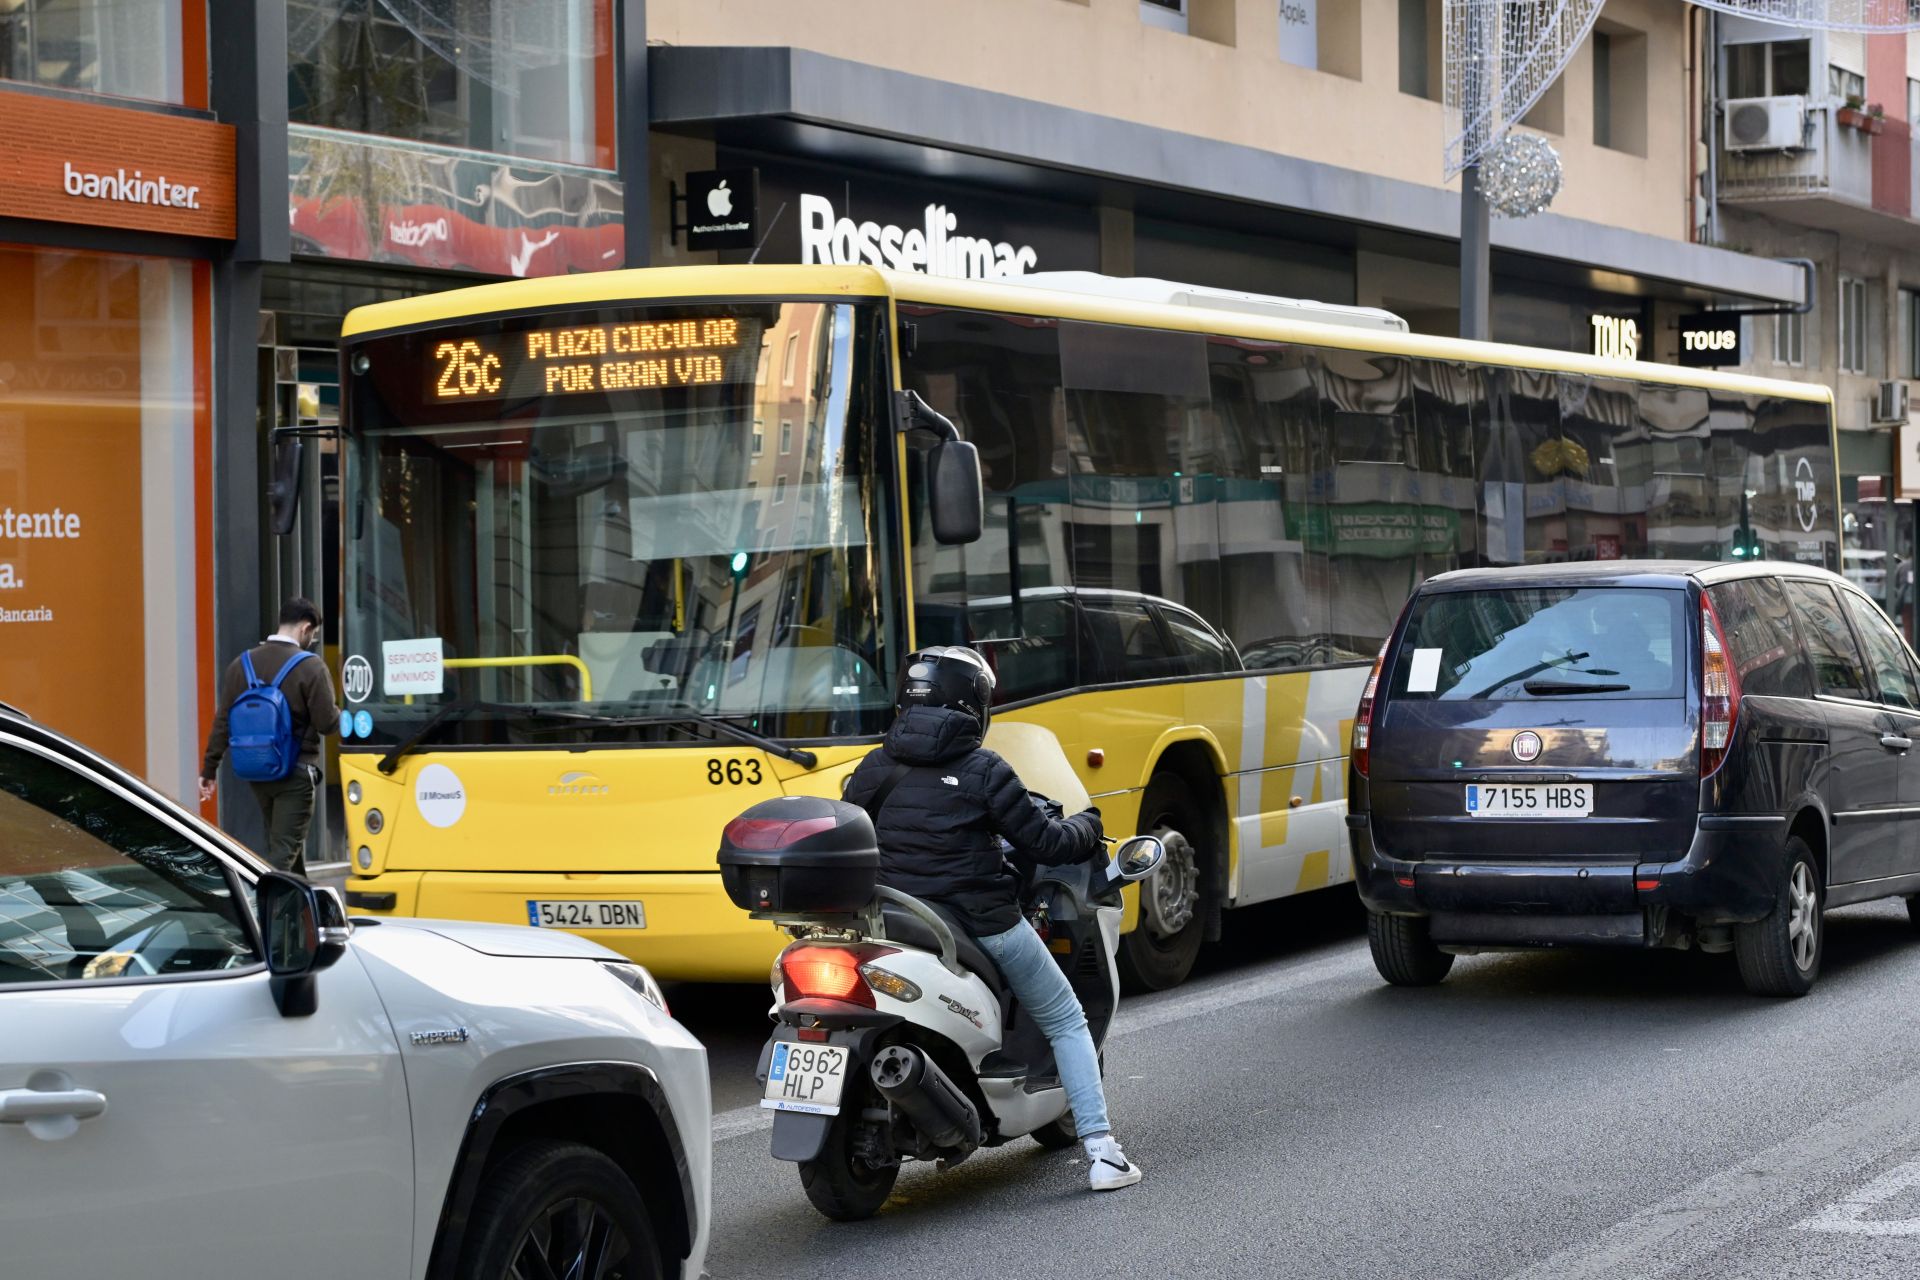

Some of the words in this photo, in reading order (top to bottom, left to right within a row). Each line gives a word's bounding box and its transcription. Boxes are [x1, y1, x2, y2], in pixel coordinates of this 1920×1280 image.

[63, 161, 200, 209] bankinter.
[800, 193, 1038, 277] Rossellimac
[528, 328, 607, 359] PLAZA
[612, 319, 738, 353] CIRCULAR
[1592, 314, 1637, 361] TOUS
[1683, 329, 1736, 350] TOUS
[546, 364, 595, 393] POR
[600, 358, 668, 389] GRAN
[675, 355, 722, 383] VIA
[1795, 480, 1816, 502] TMP
[0, 507, 81, 539] tente
[387, 651, 438, 666] SERVICIOS
[347, 664, 370, 693] 3701
[390, 669, 436, 683] MÍNIMOS
[1519, 739, 1535, 754] FIAT
[707, 758, 762, 785] 863
[1485, 788, 1537, 808] 7155
[1546, 788, 1586, 808] HBS
[541, 904, 593, 925] 5424
[599, 904, 640, 925] DBN
[410, 1029, 460, 1046] HYBRID
[774, 1065, 782, 1074] E
[788, 1048, 843, 1076] 6962
[783, 1073, 824, 1100] HLP
